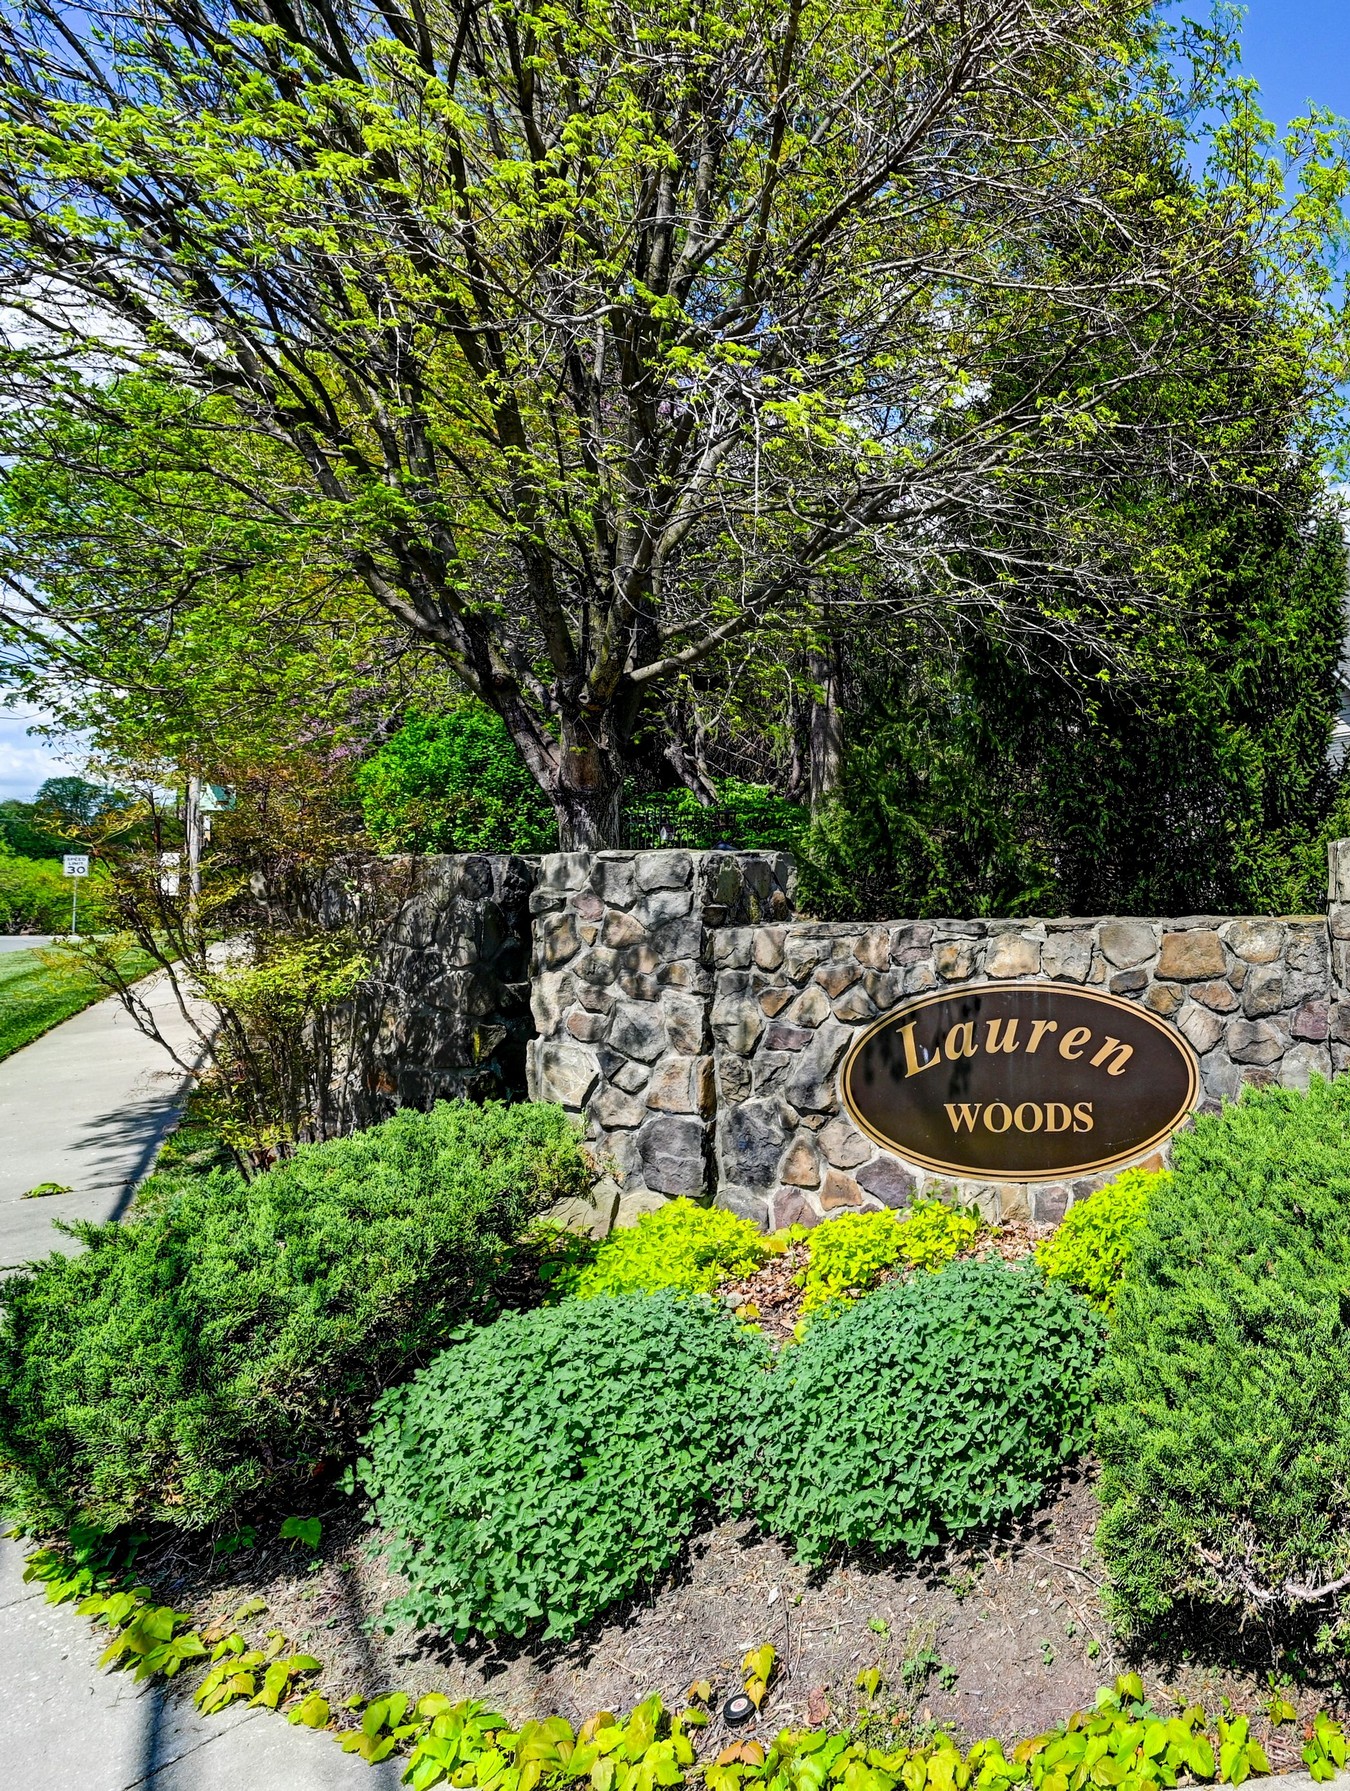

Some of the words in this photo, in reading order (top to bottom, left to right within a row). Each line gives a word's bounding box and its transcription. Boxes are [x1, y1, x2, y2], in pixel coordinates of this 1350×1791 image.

[67, 866, 86, 874] 30
[896, 1018, 1134, 1079] Lauren
[944, 1102, 1094, 1133] WOODS
